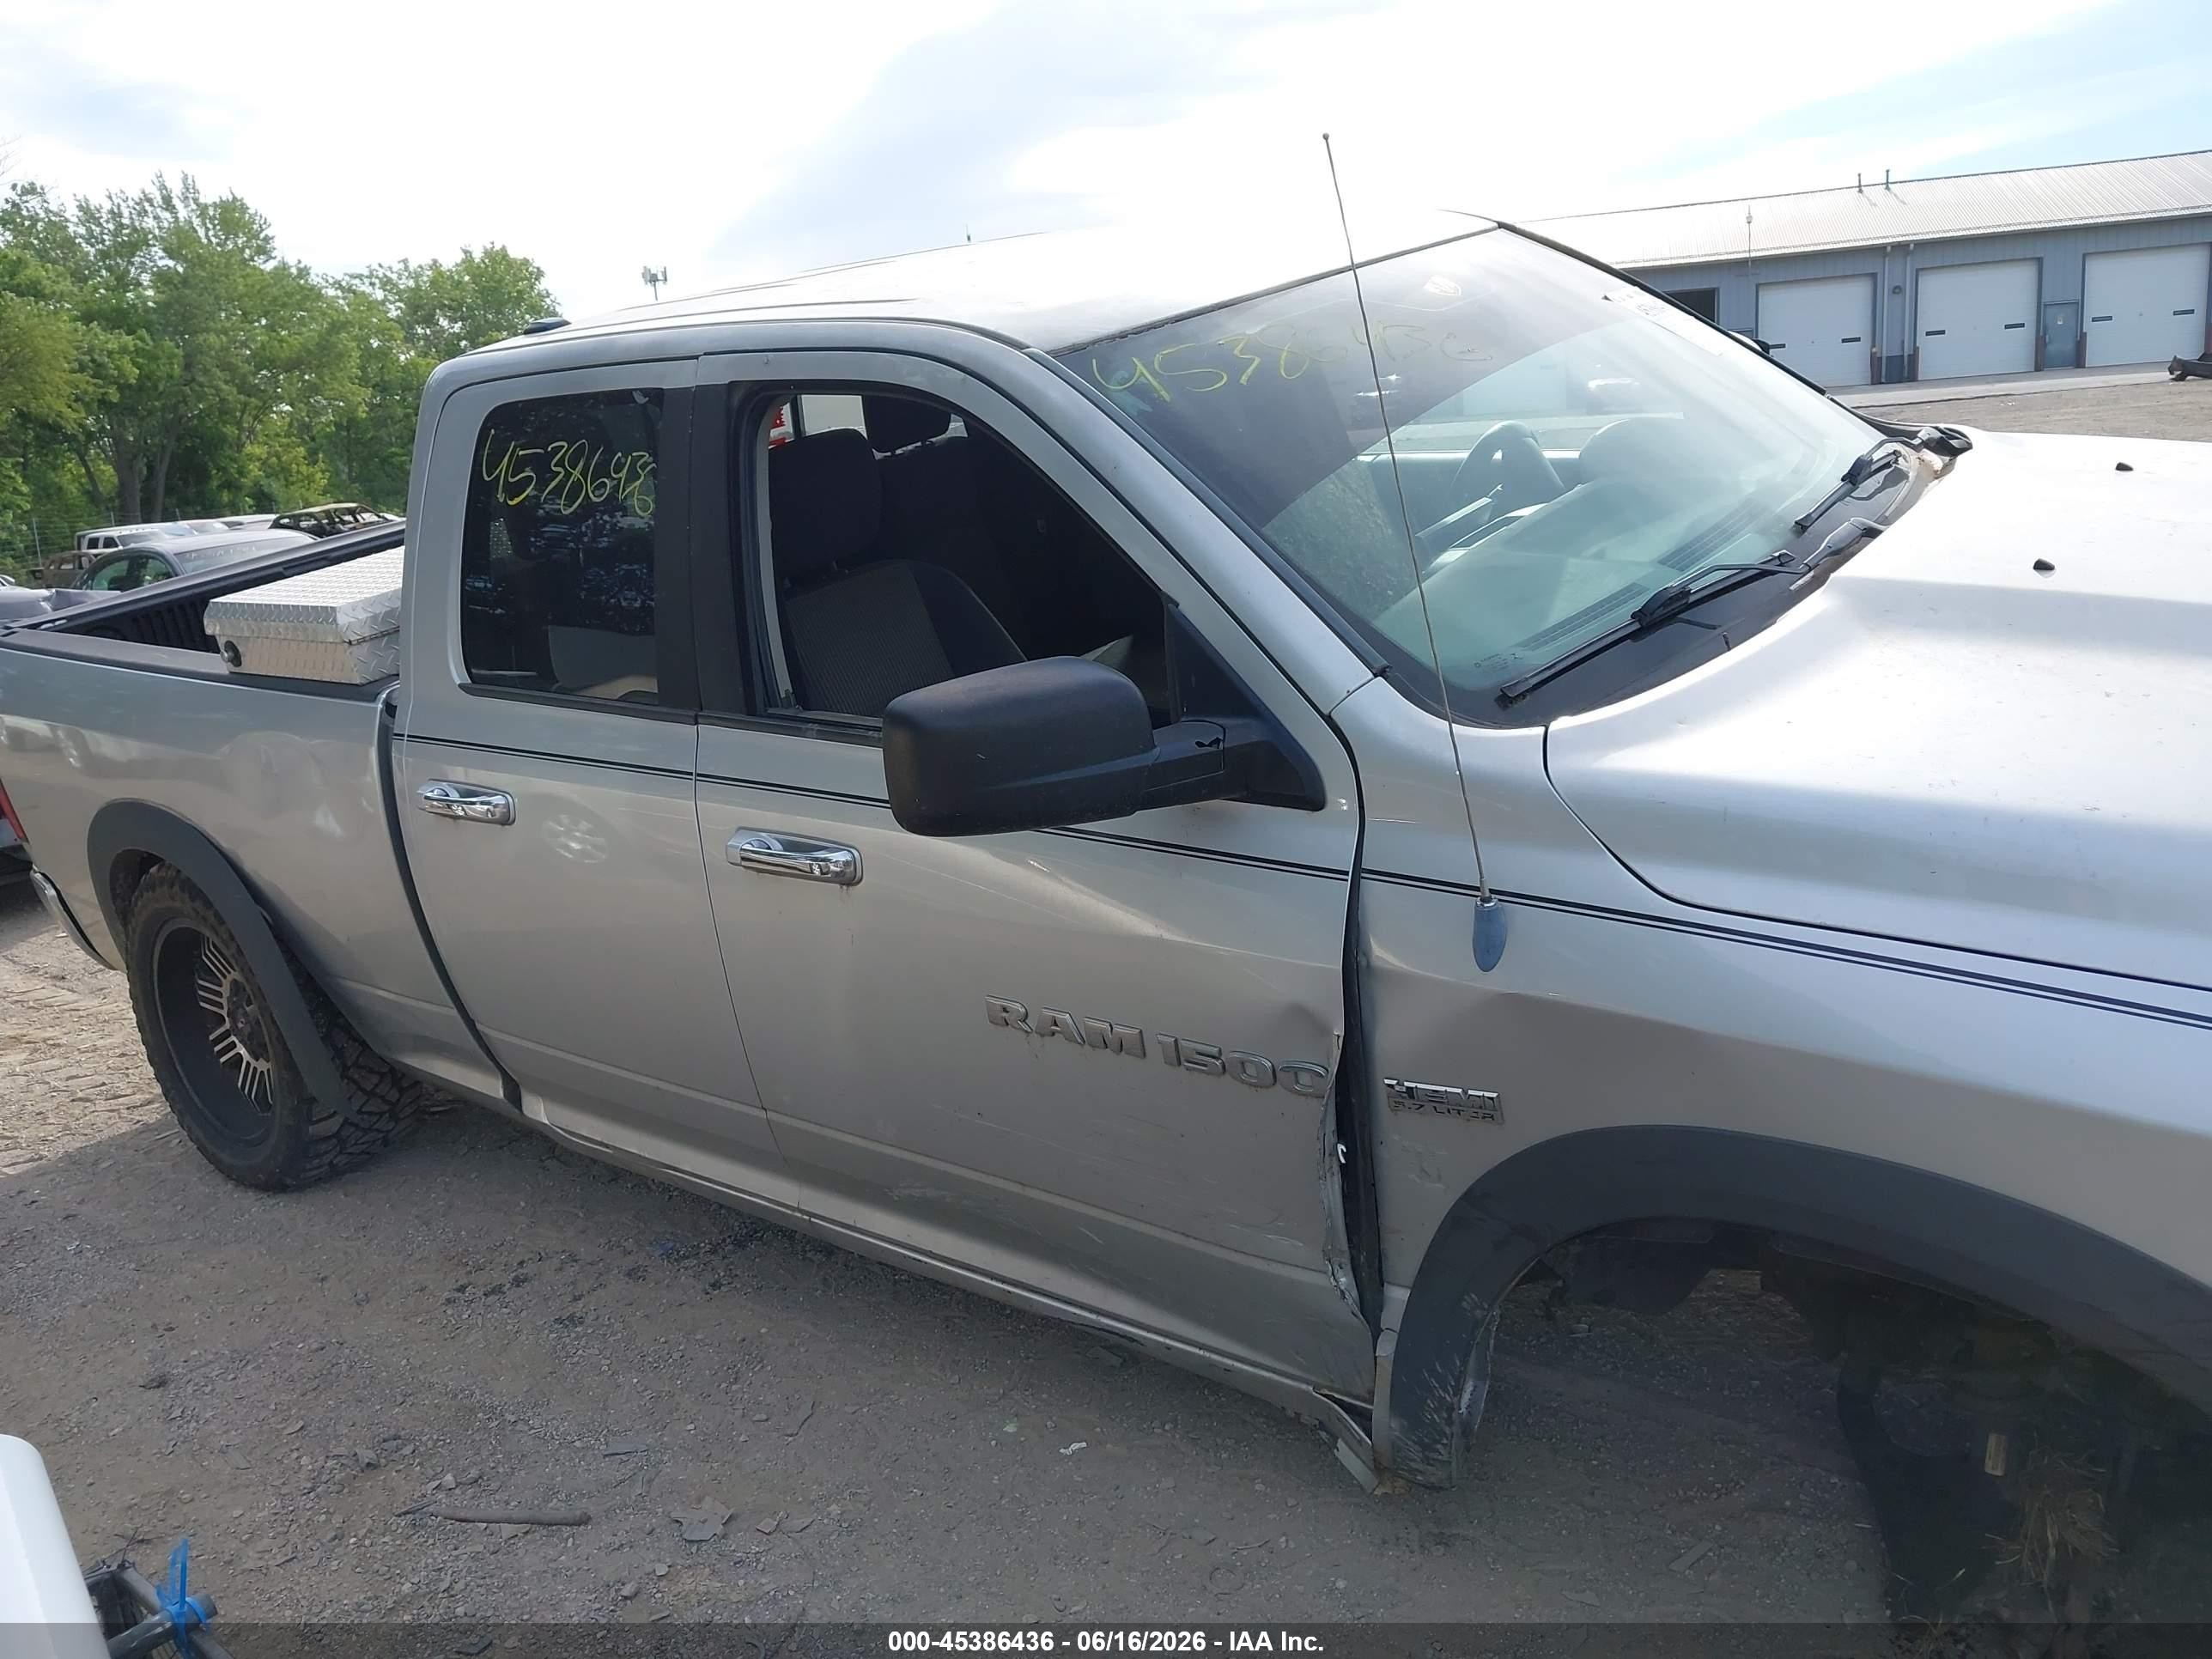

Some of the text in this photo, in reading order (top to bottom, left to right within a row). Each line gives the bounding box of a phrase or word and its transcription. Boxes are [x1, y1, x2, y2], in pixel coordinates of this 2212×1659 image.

[985, 994, 1331, 1099] RAM 1500
[1383, 1078, 1500, 1111] HEMI
[1432, 1103, 1497, 1122] LITER
